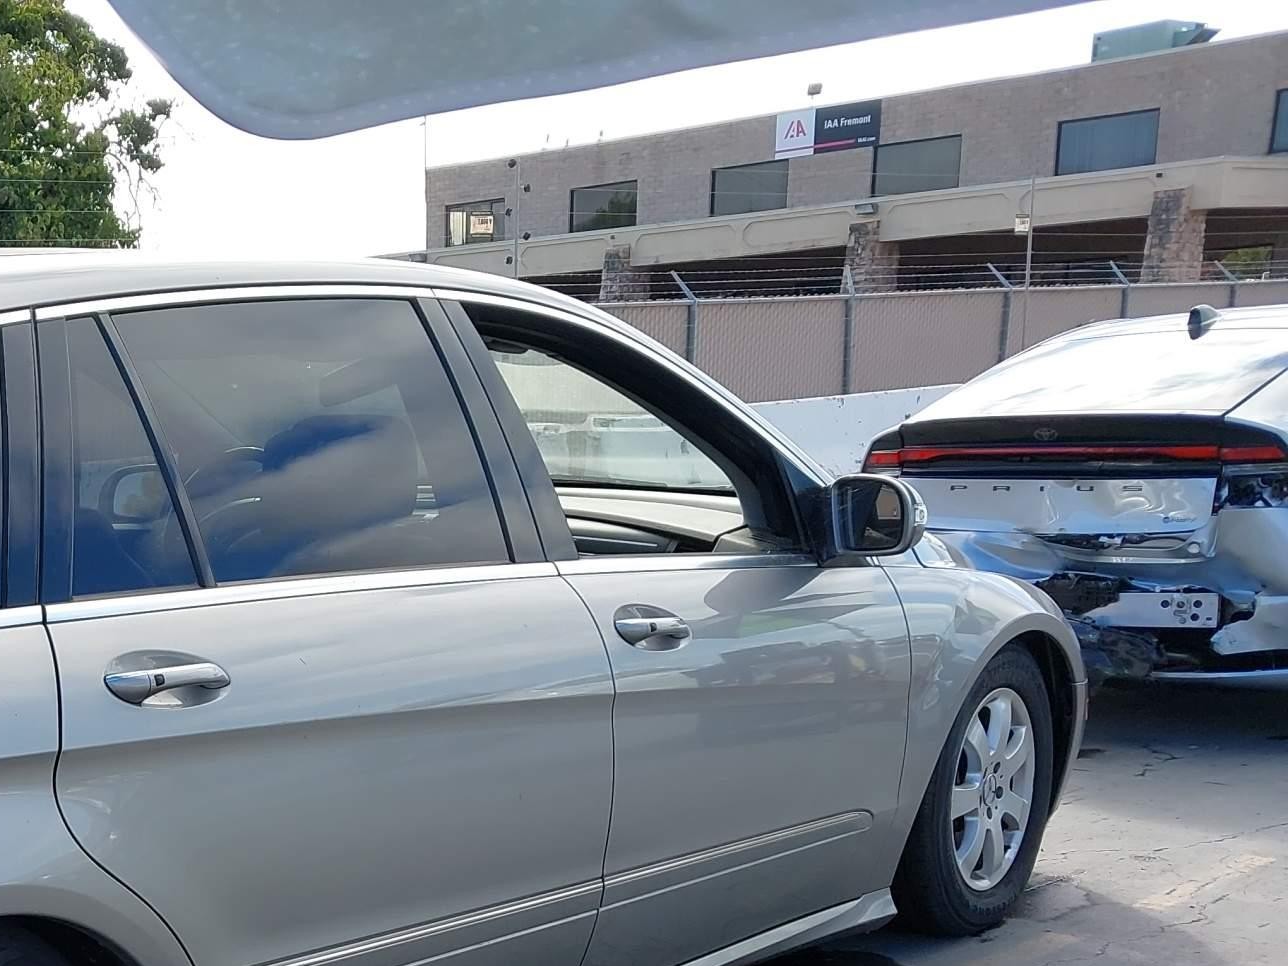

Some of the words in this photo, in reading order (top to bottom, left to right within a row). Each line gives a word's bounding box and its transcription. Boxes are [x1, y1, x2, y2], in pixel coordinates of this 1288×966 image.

[823, 118, 839, 129] IAA
[840, 115, 872, 127] Fremont
[950, 484, 1144, 492] PRIUS
